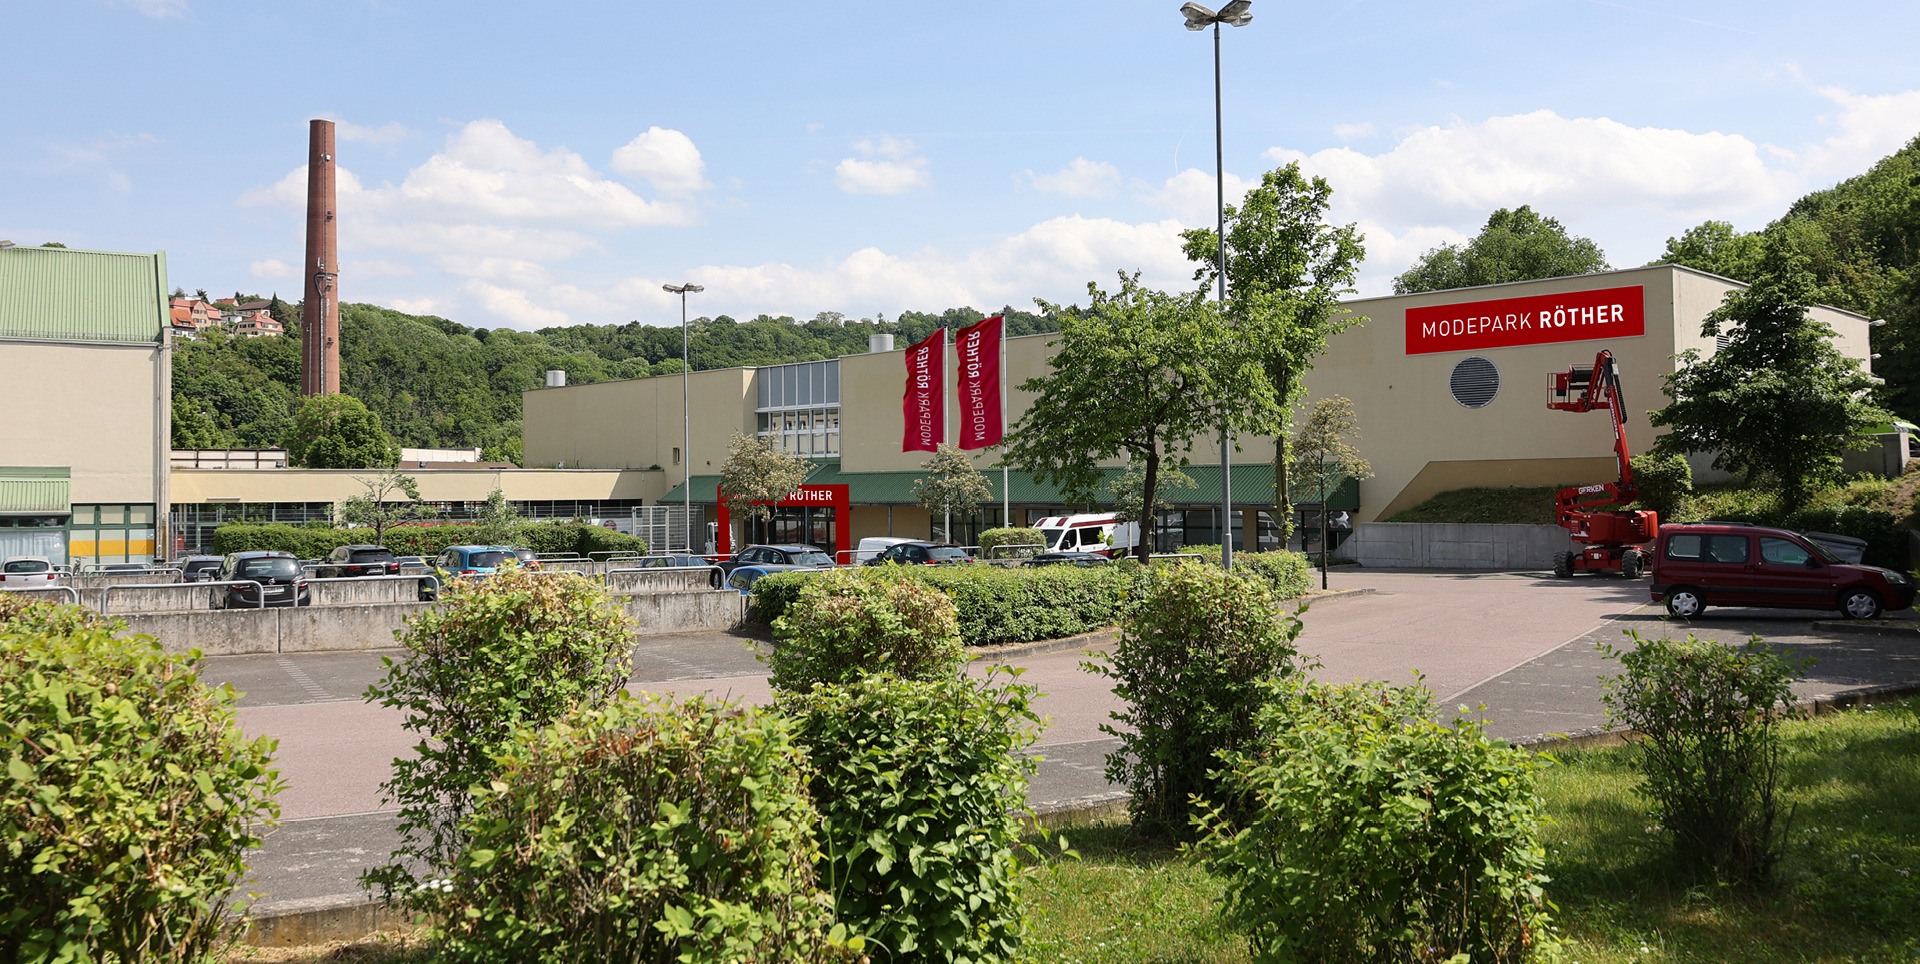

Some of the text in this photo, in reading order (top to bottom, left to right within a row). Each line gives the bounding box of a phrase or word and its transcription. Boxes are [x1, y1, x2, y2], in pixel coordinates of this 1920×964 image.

[1423, 304, 1624, 338] MODEPARK RÖTHER
[1578, 484, 1604, 495] GERKEN
